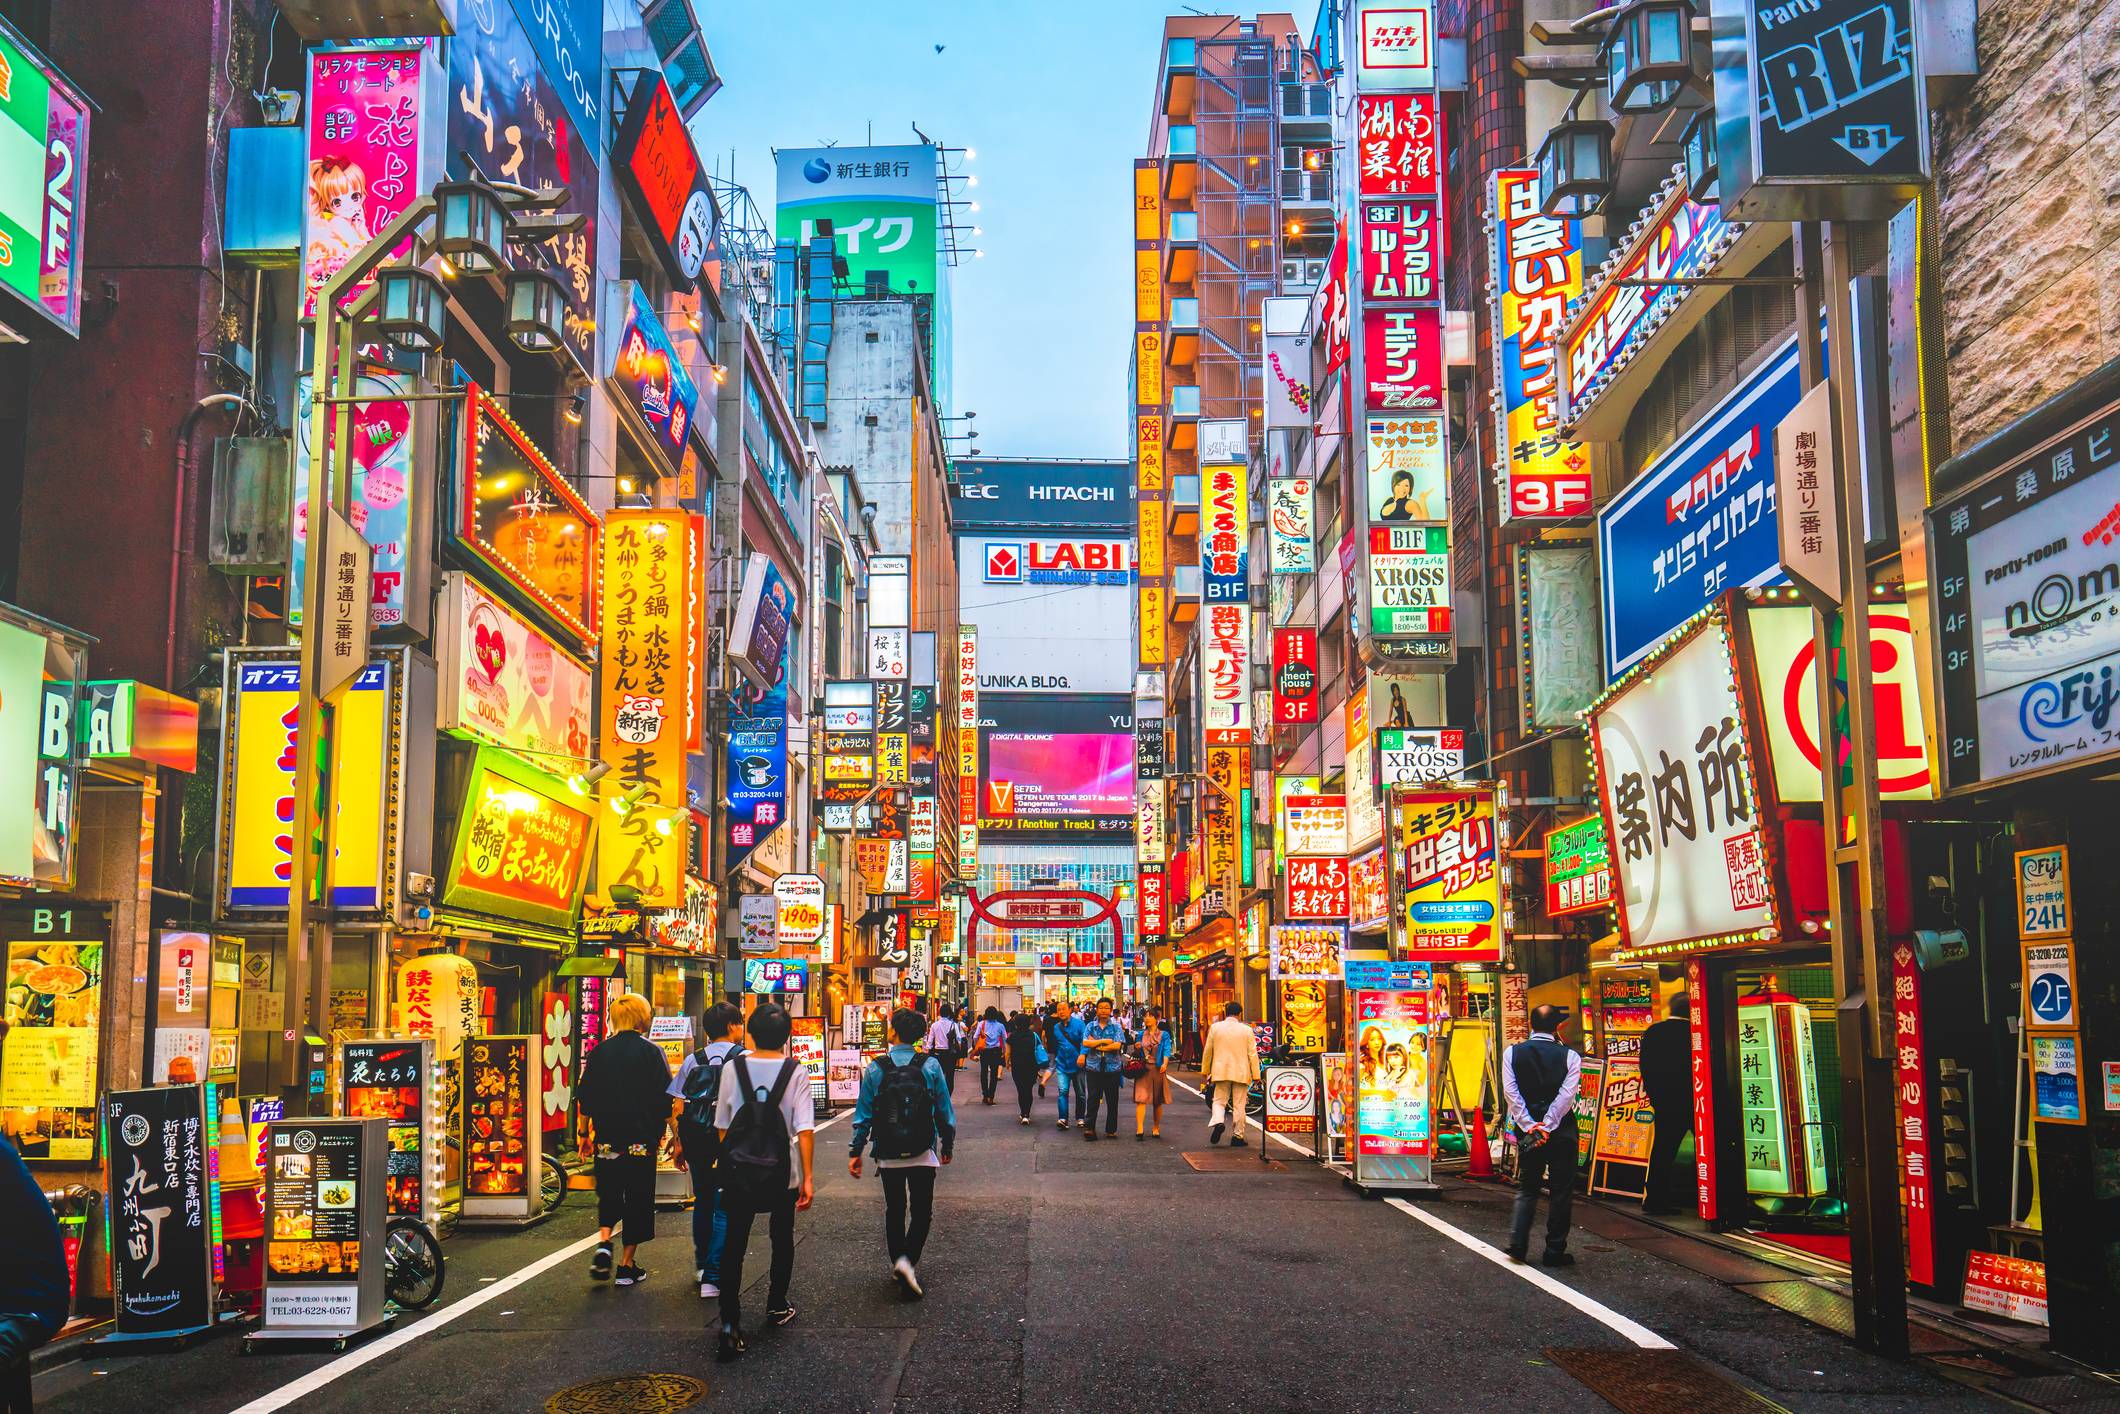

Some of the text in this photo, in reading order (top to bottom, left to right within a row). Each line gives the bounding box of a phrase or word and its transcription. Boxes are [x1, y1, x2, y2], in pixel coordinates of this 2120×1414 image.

[1370, 36, 1420, 47] ラウンジ
[1376, 25, 1416, 36] カブキ
[319, 57, 416, 75] リラクゼーション
[1760, 3, 1911, 133] RIZ
[338, 78, 395, 94] リゾート
[325, 112, 357, 126] 当ビル
[1360, 96, 1432, 139] 湖南
[324, 126, 353, 140] 6F
[1849, 127, 1888, 149] B1
[836, 160, 910, 180] 新生銀行
[1362, 142, 1434, 179] 菜館
[641, 124, 683, 220] CLOVER
[1385, 179, 1411, 193] 4F
[47, 139, 73, 268] 2F
[1370, 207, 1395, 222] 3F
[1402, 204, 1432, 297] レンタル
[1371, 229, 1402, 297] ルーム
[1294, 338, 1306, 347] 5F
[1384, 312, 1417, 383] エデン
[1382, 385, 1438, 408] Eden
[1386, 421, 1438, 434] タイ古式
[1371, 435, 1438, 448] マッサージ
[1142, 453, 1160, 487] 魚金
[1670, 431, 1754, 523] マクロス
[1030, 486, 1114, 501] HITACHI
[1271, 481, 1283, 489] 4F
[1795, 432, 1822, 555] 劇場通り一番街
[1516, 481, 1587, 513] 3F
[1212, 472, 1238, 576] まぐろ商店
[1393, 530, 1423, 549] B1F
[1028, 542, 1122, 570] LABI
[1984, 536, 2067, 585] Party-room
[1030, 571, 1092, 585] SHINJUKU
[1374, 567, 1445, 586] XROSS
[1704, 561, 1728, 596] 2F
[1943, 576, 1965, 599] 5F
[1207, 582, 1244, 600] B1F
[1382, 587, 1438, 606] CASA
[333, 551, 358, 658] 劇場通り一番街
[614, 525, 640, 692] 九州のうまかもん
[1945, 613, 1967, 634] 4F
[643, 624, 671, 694] 水炊き
[873, 635, 889, 672] 桜島
[1208, 605, 1248, 700] 熟女キャバクラ
[1381, 643, 1450, 655] 第一大滝ビル
[1285, 663, 1316, 681] meat
[1947, 651, 1969, 672] 3F
[961, 641, 975, 720] お好み焼き
[1031, 676, 1072, 689] BLDG.
[1281, 676, 1311, 696] house
[886, 684, 905, 729] リラク
[1285, 702, 1308, 720] 3F
[618, 711, 658, 743] 新宿の
[733, 719, 783, 732] GREAT
[738, 732, 776, 746] BLUE
[1218, 731, 1239, 743] 4F
[1384, 735, 1394, 744] 肉
[1953, 737, 1975, 758] 2F
[42, 692, 69, 831] B1
[886, 736, 903, 767] 麻雀
[1387, 752, 1458, 767] XROSS
[886, 769, 904, 782] 2F
[1142, 768, 1160, 776] 3F
[1396, 768, 1451, 782] CASA
[1014, 785, 1041, 793] SE7EN
[1614, 716, 1752, 864] 案内所
[1310, 798, 1324, 806] 2F
[616, 748, 664, 897] まっちゃん
[1303, 809, 1345, 820] タイ古式
[1410, 795, 1480, 836] キラリ
[1290, 821, 1345, 832] マッサージ
[471, 813, 506, 873] 新宿の
[1409, 818, 1492, 885] 出会い
[891, 841, 904, 881] 居酒屋
[1727, 837, 1758, 872] 歌舞
[503, 834, 571, 899] まっちゃん
[1142, 864, 1160, 873] 焼肉
[1291, 858, 1346, 889] 湖南
[910, 860, 923, 900] ステップ
[1443, 858, 1494, 898] カフェ
[1291, 889, 1334, 915] 菜館
[1335, 890, 1346, 915] 4F
[1732, 874, 1765, 909] 伎町
[2025, 891, 2065, 905] 年中無休
[1009, 904, 1081, 915] 歌舞伎町一番街
[1144, 878, 1161, 930] 安楽亭
[1421, 904, 1483, 914] 女性は全て無料!
[34, 909, 73, 934] B1
[2025, 904, 2067, 931] 24H
[1145, 935, 1160, 944] 2F
[1416, 936, 1469, 948] 受付3F
[185, 968, 193, 1006] 防犯カメラ
[763, 962, 802, 992] 麻雀
[2035, 978, 2068, 1012] 2F
[349, 1048, 374, 1057] 鍋料理
[1306, 1036, 1325, 1047] B1
[349, 1060, 417, 1084] 花たろう
[1272, 1092, 1310, 1100] ラウンジ
[1276, 1084, 1306, 1092] カブキ
[1739, 1023, 1771, 1169] 無料案内所
[1895, 976, 1926, 1210] 絶対安心宣言!!
[110, 1103, 123, 1118] 3F
[259, 1110, 281, 1121] カフェ
[1606, 1107, 1633, 1122] キラリ
[1268, 1123, 1313, 1133] COFFEE
[275, 1134, 290, 1147] 6F
[162, 1119, 180, 1189] 新宿東口店
[182, 1117, 202, 1228] 博多水炊き専門店
[123, 1153, 172, 1280] 九州小町
[1971, 1255, 2045, 1278] ここにごみを
[1964, 1295, 1995, 1307] garbage
[1965, 1285, 2048, 1309] Please do not throw
[271, 1306, 352, 1316] TEL:03-6228-0567
